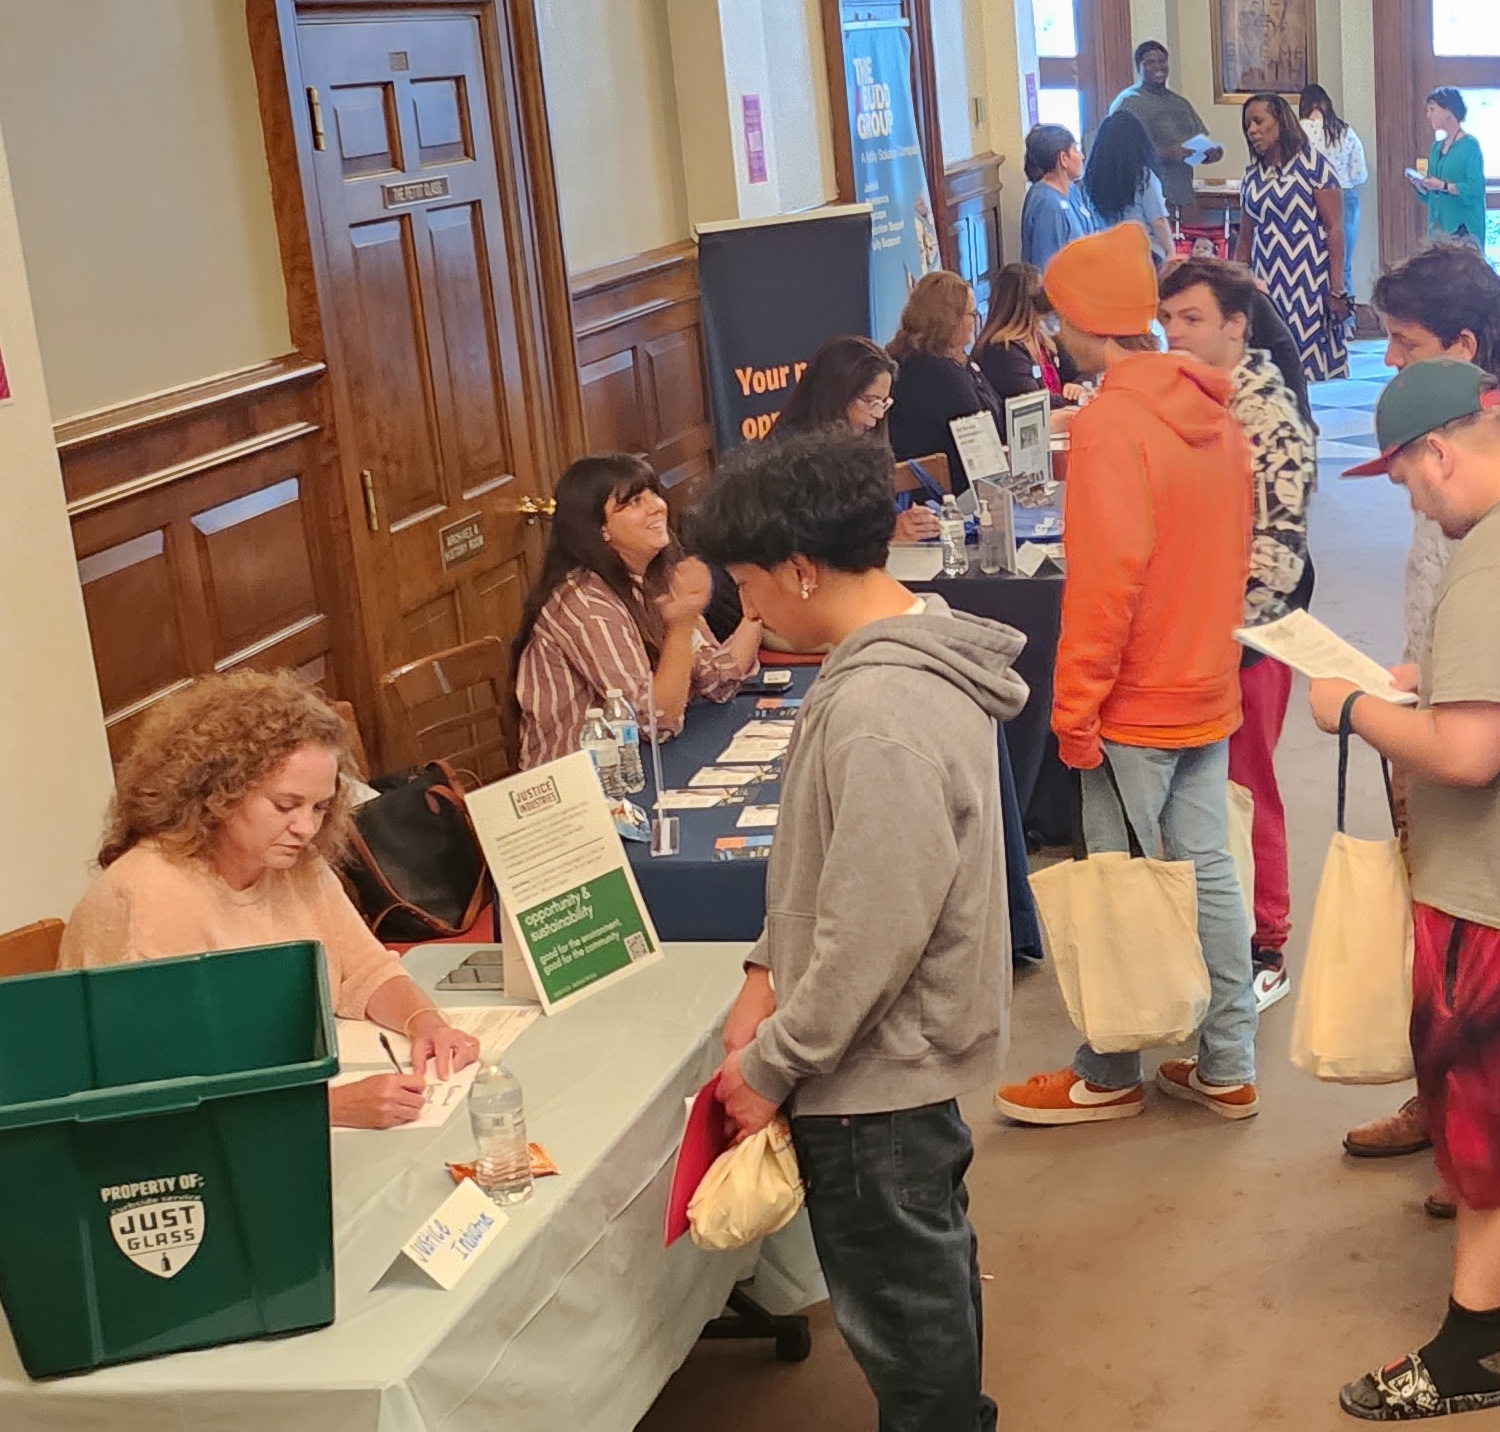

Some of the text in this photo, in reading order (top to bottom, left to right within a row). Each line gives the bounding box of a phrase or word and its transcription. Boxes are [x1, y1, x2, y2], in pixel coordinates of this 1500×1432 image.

[853, 56, 874, 86] THE
[857, 109, 894, 140] GROUP
[735, 366, 790, 396] Your
[516, 780, 553, 803] JUSTICE
[519, 791, 557, 813] INDUSTRIES
[525, 885, 592, 927] opportunity &
[530, 904, 593, 941] sustainability
[101, 1177, 176, 1203] PROPERTY
[120, 1204, 195, 1235] JUST
[127, 1228, 195, 1250] GLASS
